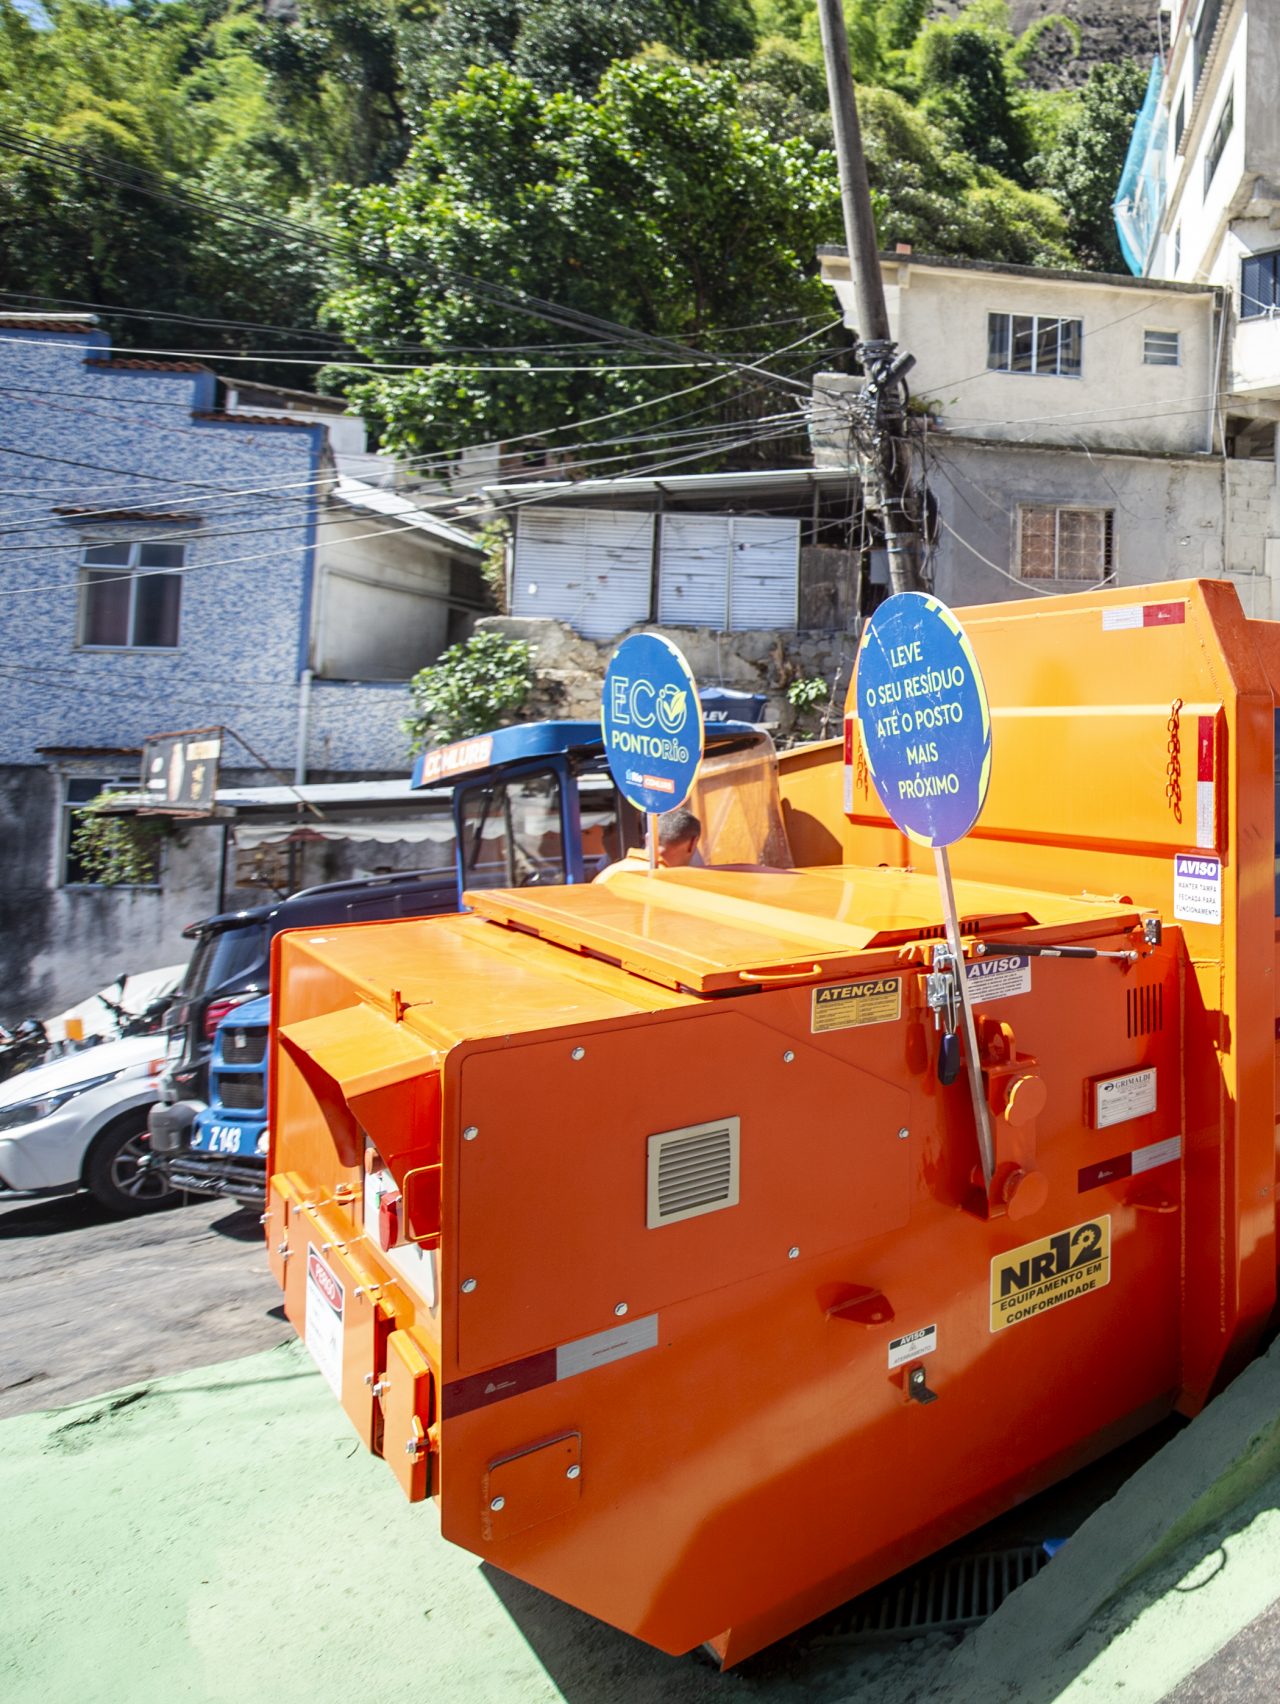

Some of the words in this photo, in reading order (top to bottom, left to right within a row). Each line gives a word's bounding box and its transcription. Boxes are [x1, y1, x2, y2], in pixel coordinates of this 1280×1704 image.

[890, 641, 923, 668] LEVE
[866, 688, 876, 707] O
[878, 681, 901, 705] SEU
[904, 666, 965, 699] RESÍDUO
[611, 675, 687, 734] ECO
[877, 709, 900, 738] ATÉ
[901, 713, 913, 732] O
[915, 702, 963, 730] POSTO
[425, 740, 492, 777] COMLURB
[906, 742, 939, 766] MAIS
[898, 772, 960, 799] PRÓXIMO
[1178, 860, 1217, 876] AVISO
[968, 956, 1021, 978] AVISO
[819, 975, 897, 1001] ATENÇÃO
[1115, 1073, 1151, 1089] GRIMALDI
[1000, 1223, 1102, 1297] NR12
[1000, 1271, 1083, 1312] EQUIPAMENTO
[1086, 1262, 1102, 1276] EM
[1006, 1279, 1097, 1324] CONFORMIDADE
[900, 1330, 926, 1345] AVISO
